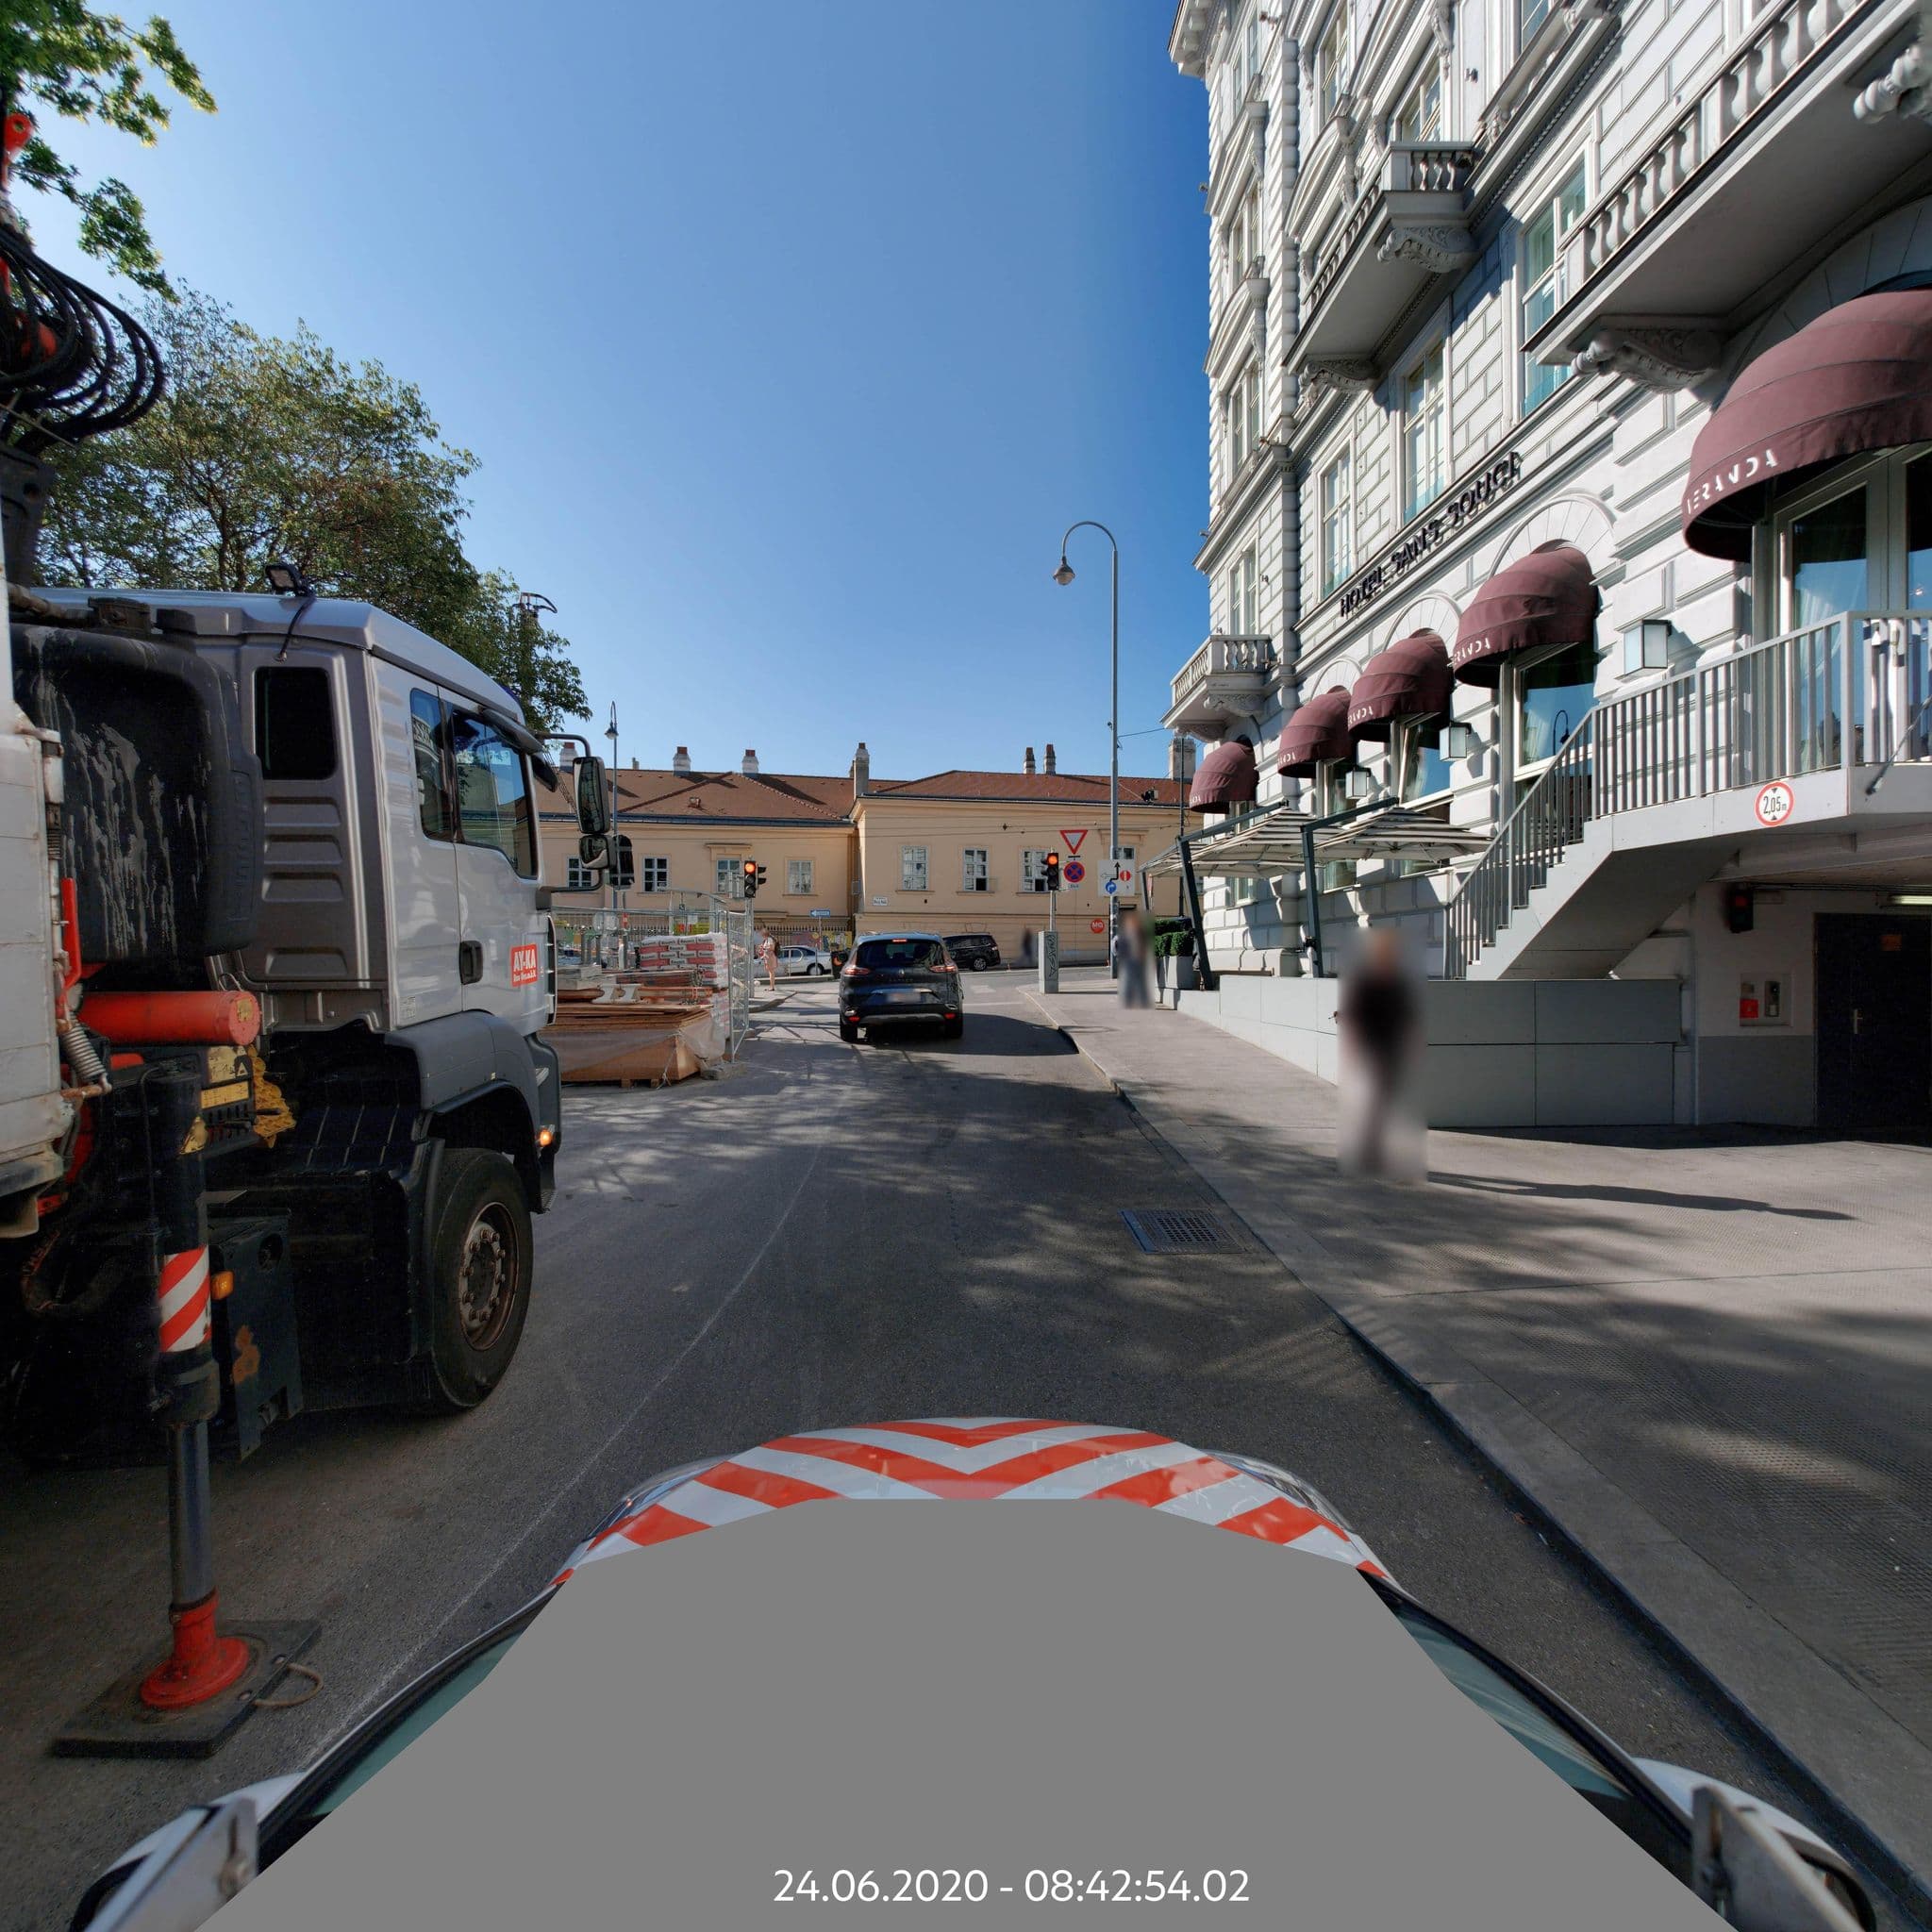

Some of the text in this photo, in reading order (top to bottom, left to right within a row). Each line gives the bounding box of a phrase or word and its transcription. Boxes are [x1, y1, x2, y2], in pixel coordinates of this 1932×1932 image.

[1340, 450, 1521, 617] HOTEL SANS SOUCI
